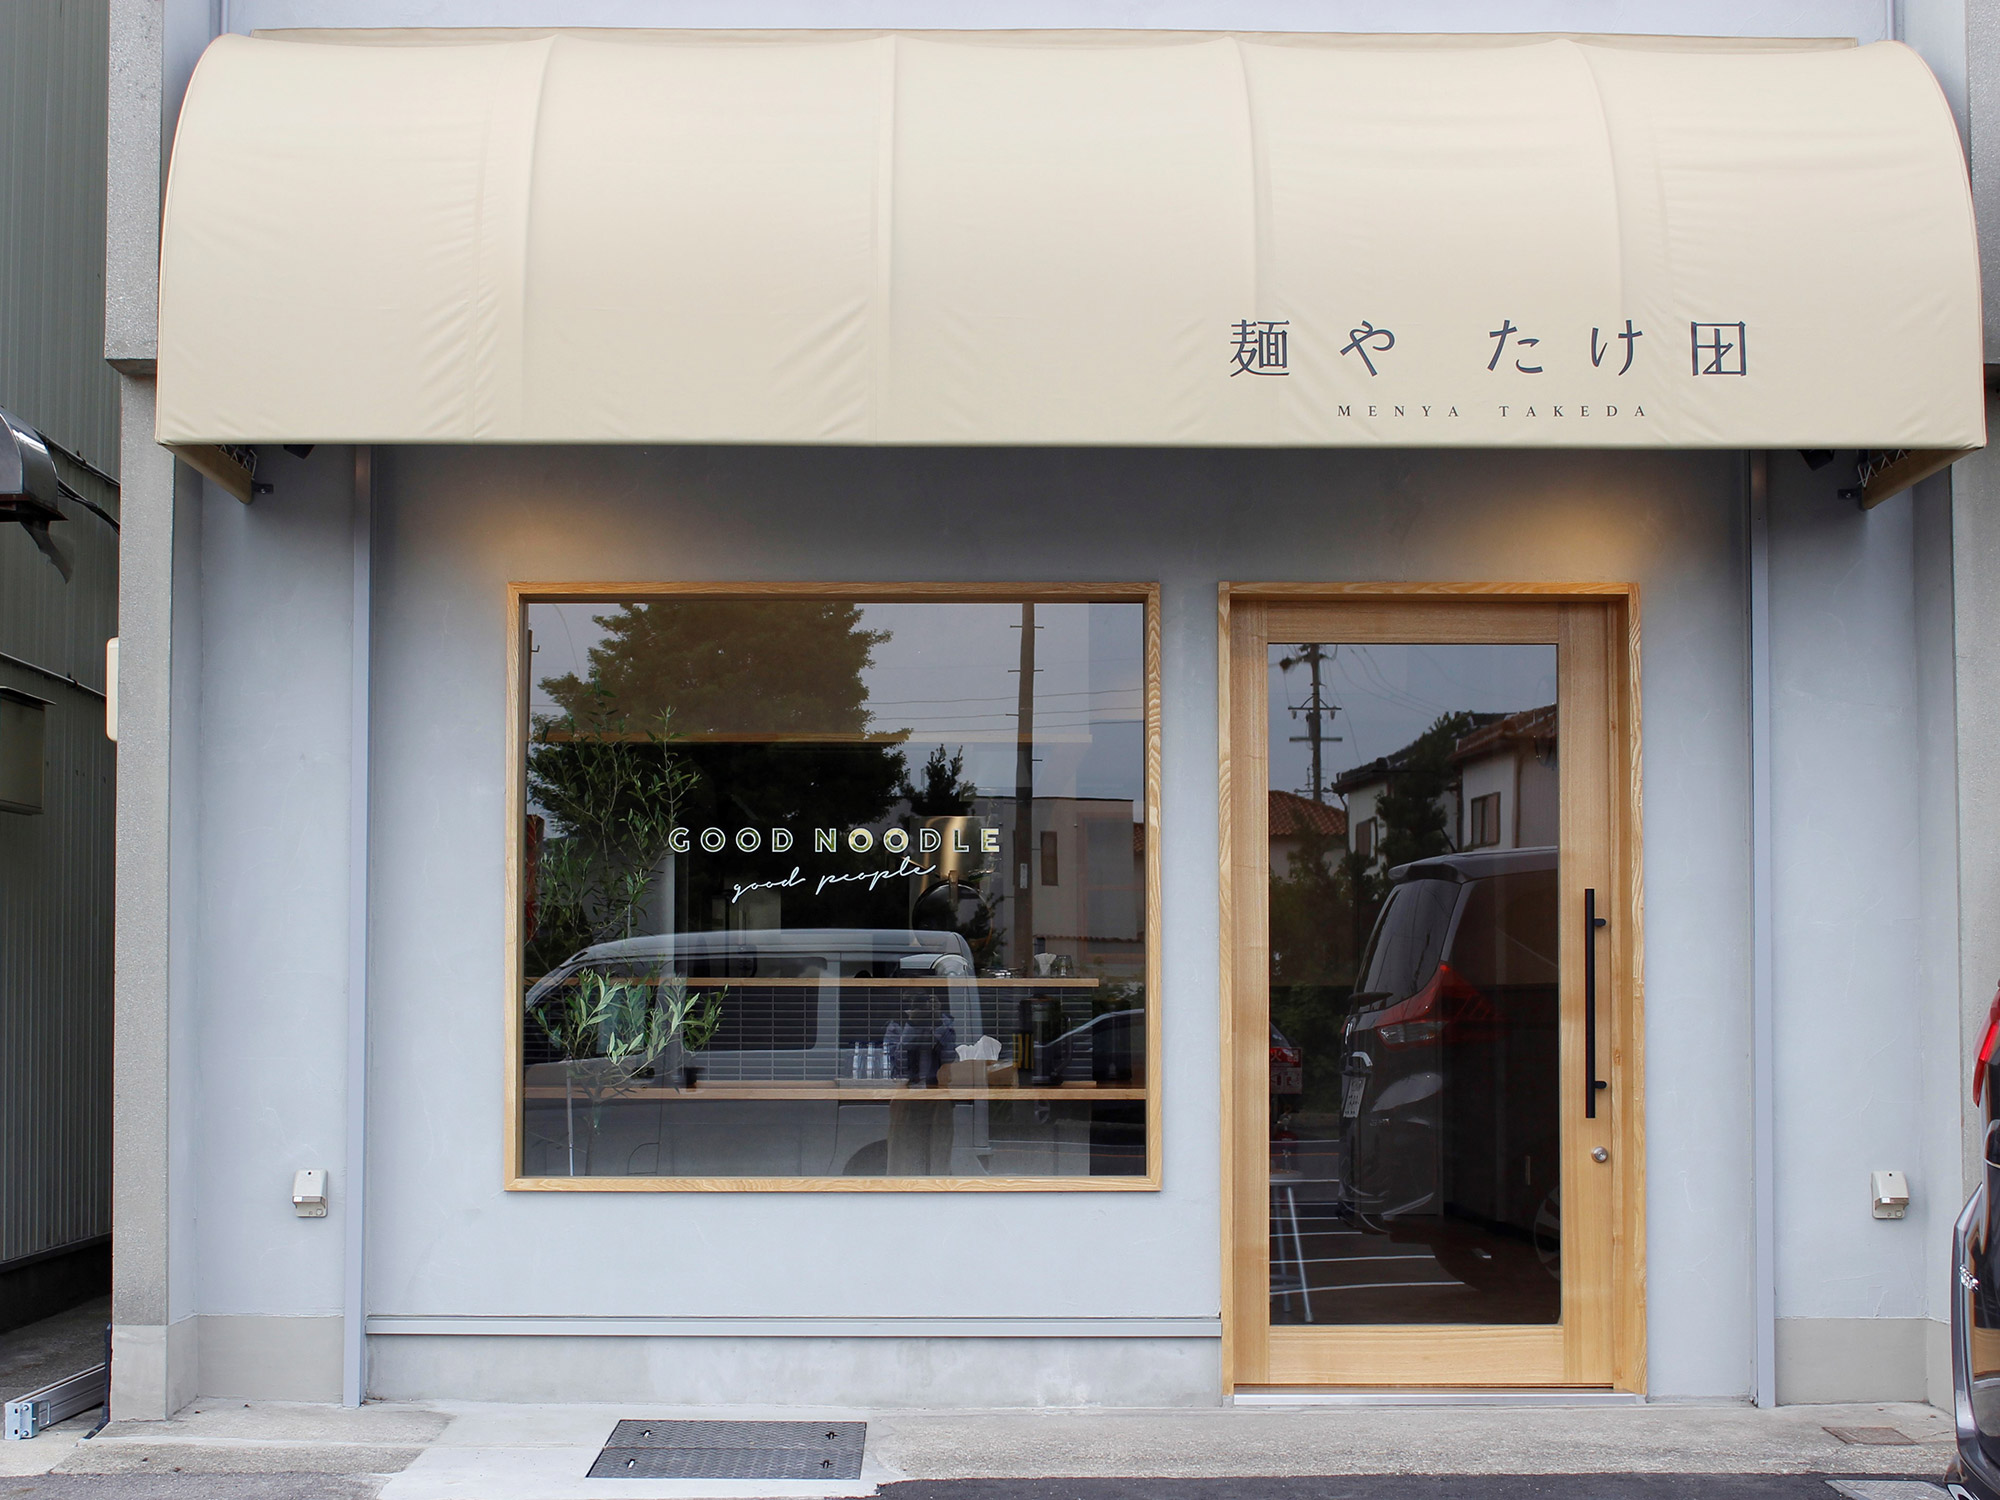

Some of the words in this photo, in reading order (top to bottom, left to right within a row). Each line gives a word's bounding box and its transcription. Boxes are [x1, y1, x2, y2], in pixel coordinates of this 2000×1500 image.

[1337, 404, 1460, 418] MENYA
[1498, 404, 1646, 418] TAKEDA
[667, 826, 794, 853] GOOD
[814, 827, 1001, 853] NOODLE
[731, 865, 807, 904] good
[814, 855, 937, 896] people
